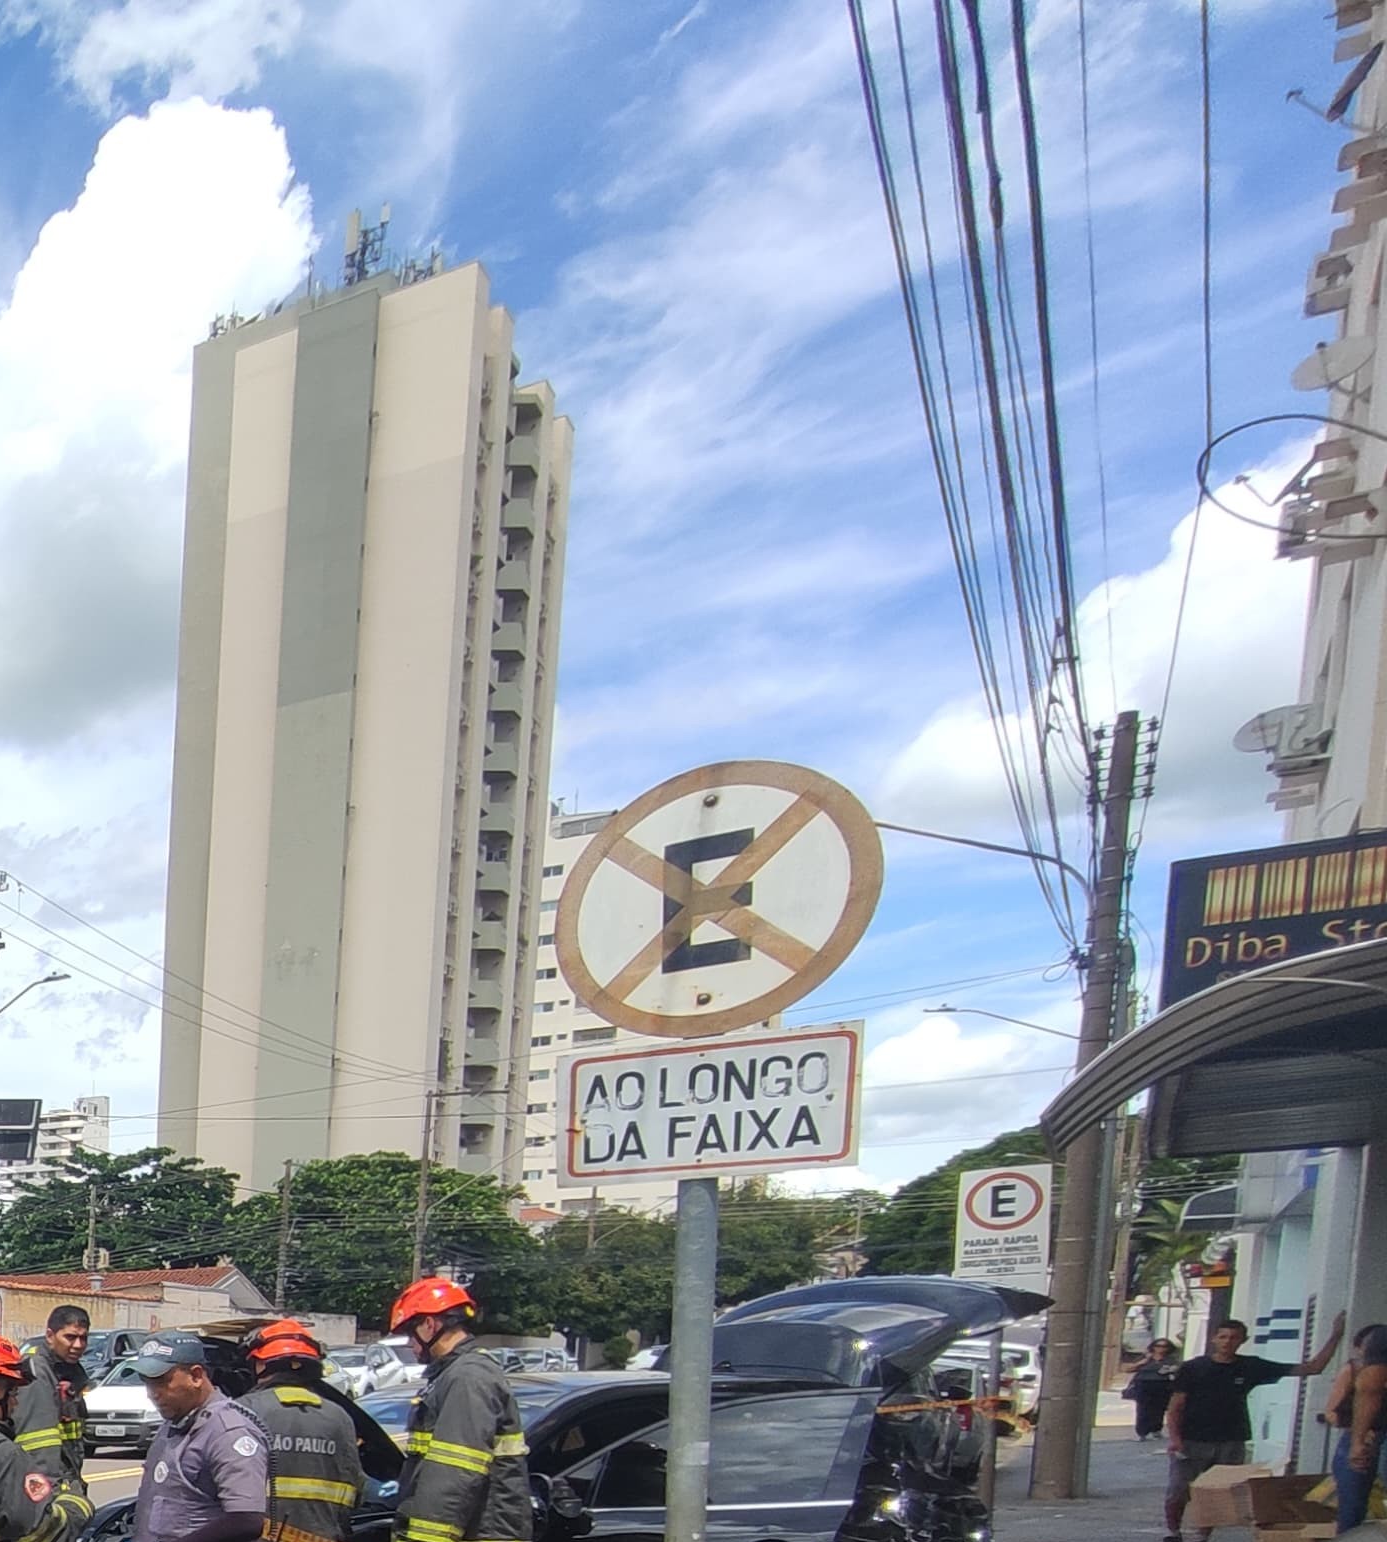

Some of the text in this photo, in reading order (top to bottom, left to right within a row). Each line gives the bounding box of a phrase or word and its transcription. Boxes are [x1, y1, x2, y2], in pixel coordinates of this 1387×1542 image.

[662, 827, 755, 974] E
[1185, 931, 1289, 968] Diba
[586, 1051, 829, 1114] AO LONGO
[583, 1104, 822, 1165] DA FAIXA
[990, 1184, 1017, 1218] E
[963, 1238, 999, 1248] PARADA
[271, 1433, 336, 1455] ÃO PAULO
